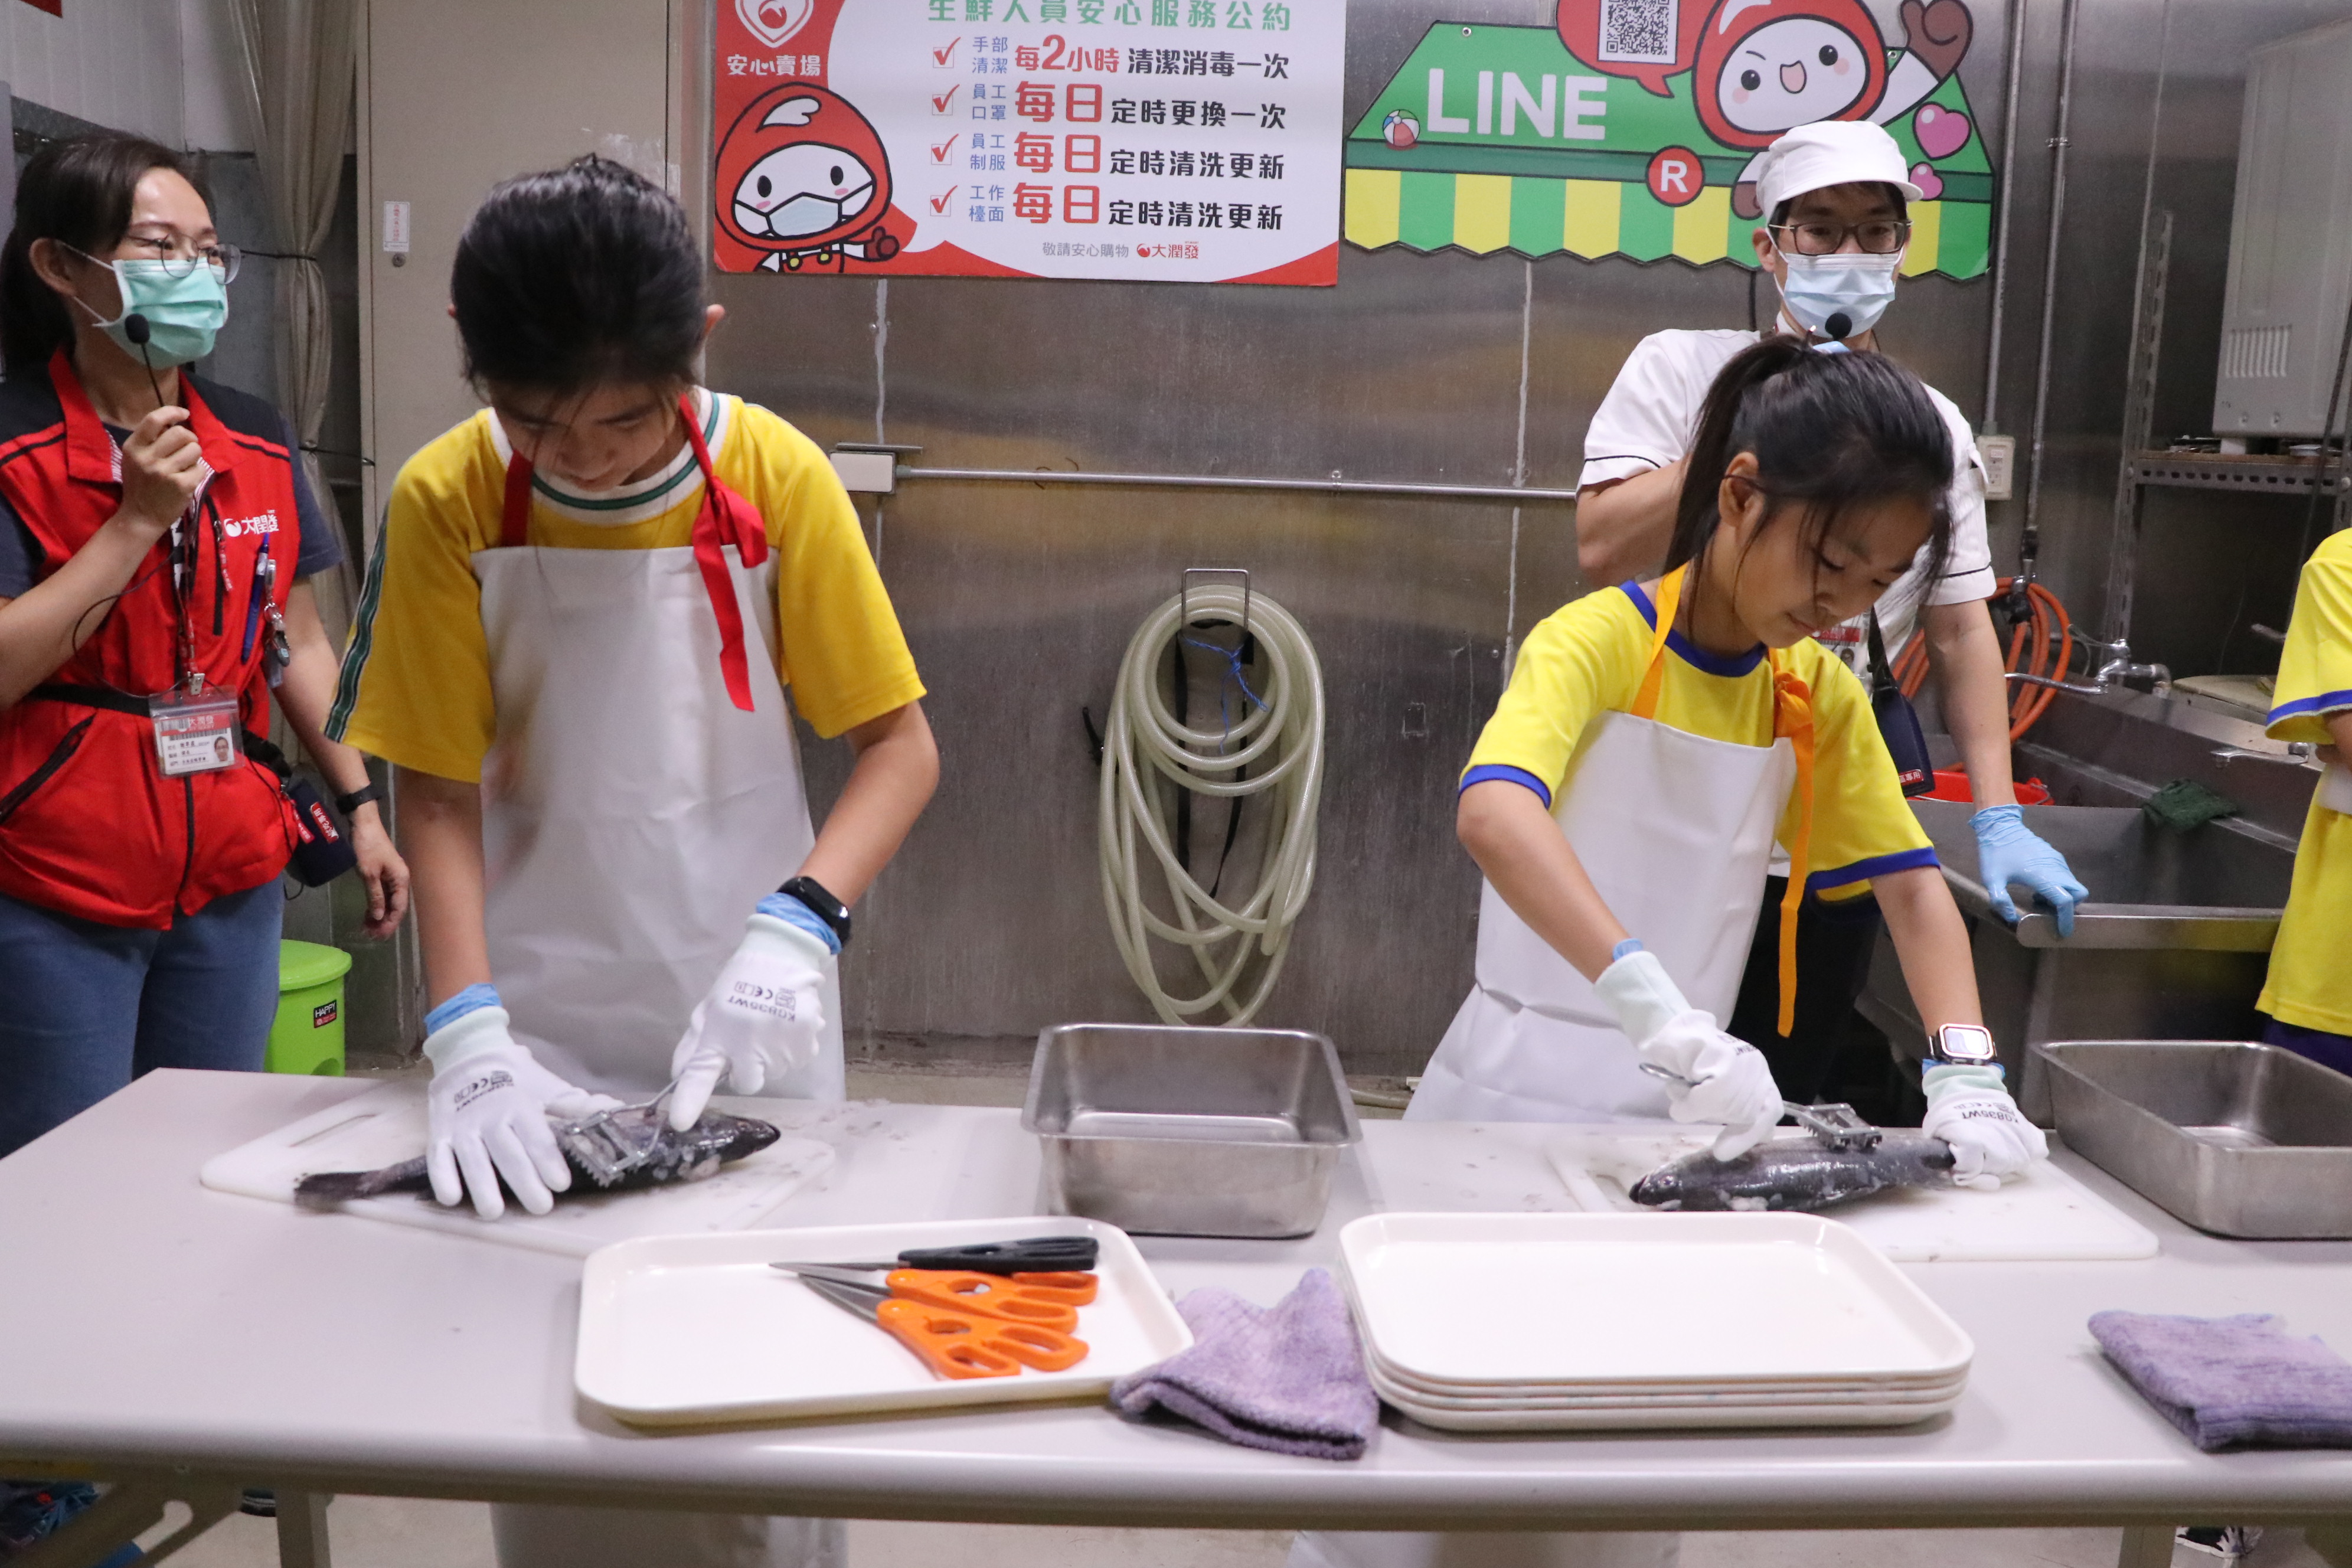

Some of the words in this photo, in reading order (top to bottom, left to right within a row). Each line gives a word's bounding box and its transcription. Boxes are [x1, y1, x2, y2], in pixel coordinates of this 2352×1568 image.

[928, 0, 1291, 31] 生鮮人員安心服務公約
[972, 36, 1008, 53] 手部
[727, 54, 821, 76] 安心賣場
[1015, 34, 1120, 73] 每2小時
[1128, 48, 1289, 79] 清潔消毒一次
[972, 57, 1008, 74] 清潔
[972, 84, 1007, 100] 員工
[1015, 80, 1103, 123] 每日
[1110, 98, 1286, 129] 定時更換一次
[1427, 68, 1608, 140] LINE
[972, 105, 1006, 121] 口罩
[972, 133, 1005, 149] 員工
[970, 154, 1005, 171] 制服
[1014, 131, 1102, 173] 每日
[1110, 149, 1285, 180] 定時清洗更新
[1661, 160, 1688, 192] R
[969, 184, 1005, 201] 工作
[969, 205, 1004, 222] 檯面
[1012, 182, 1100, 224] 每日
[1108, 199, 1283, 230] 定時清洗更新
[1042, 241, 1129, 258] 敬請安心購物
[1152, 243, 1199, 259] 大潤發
[315, 1002, 335, 1018] HAPPY
